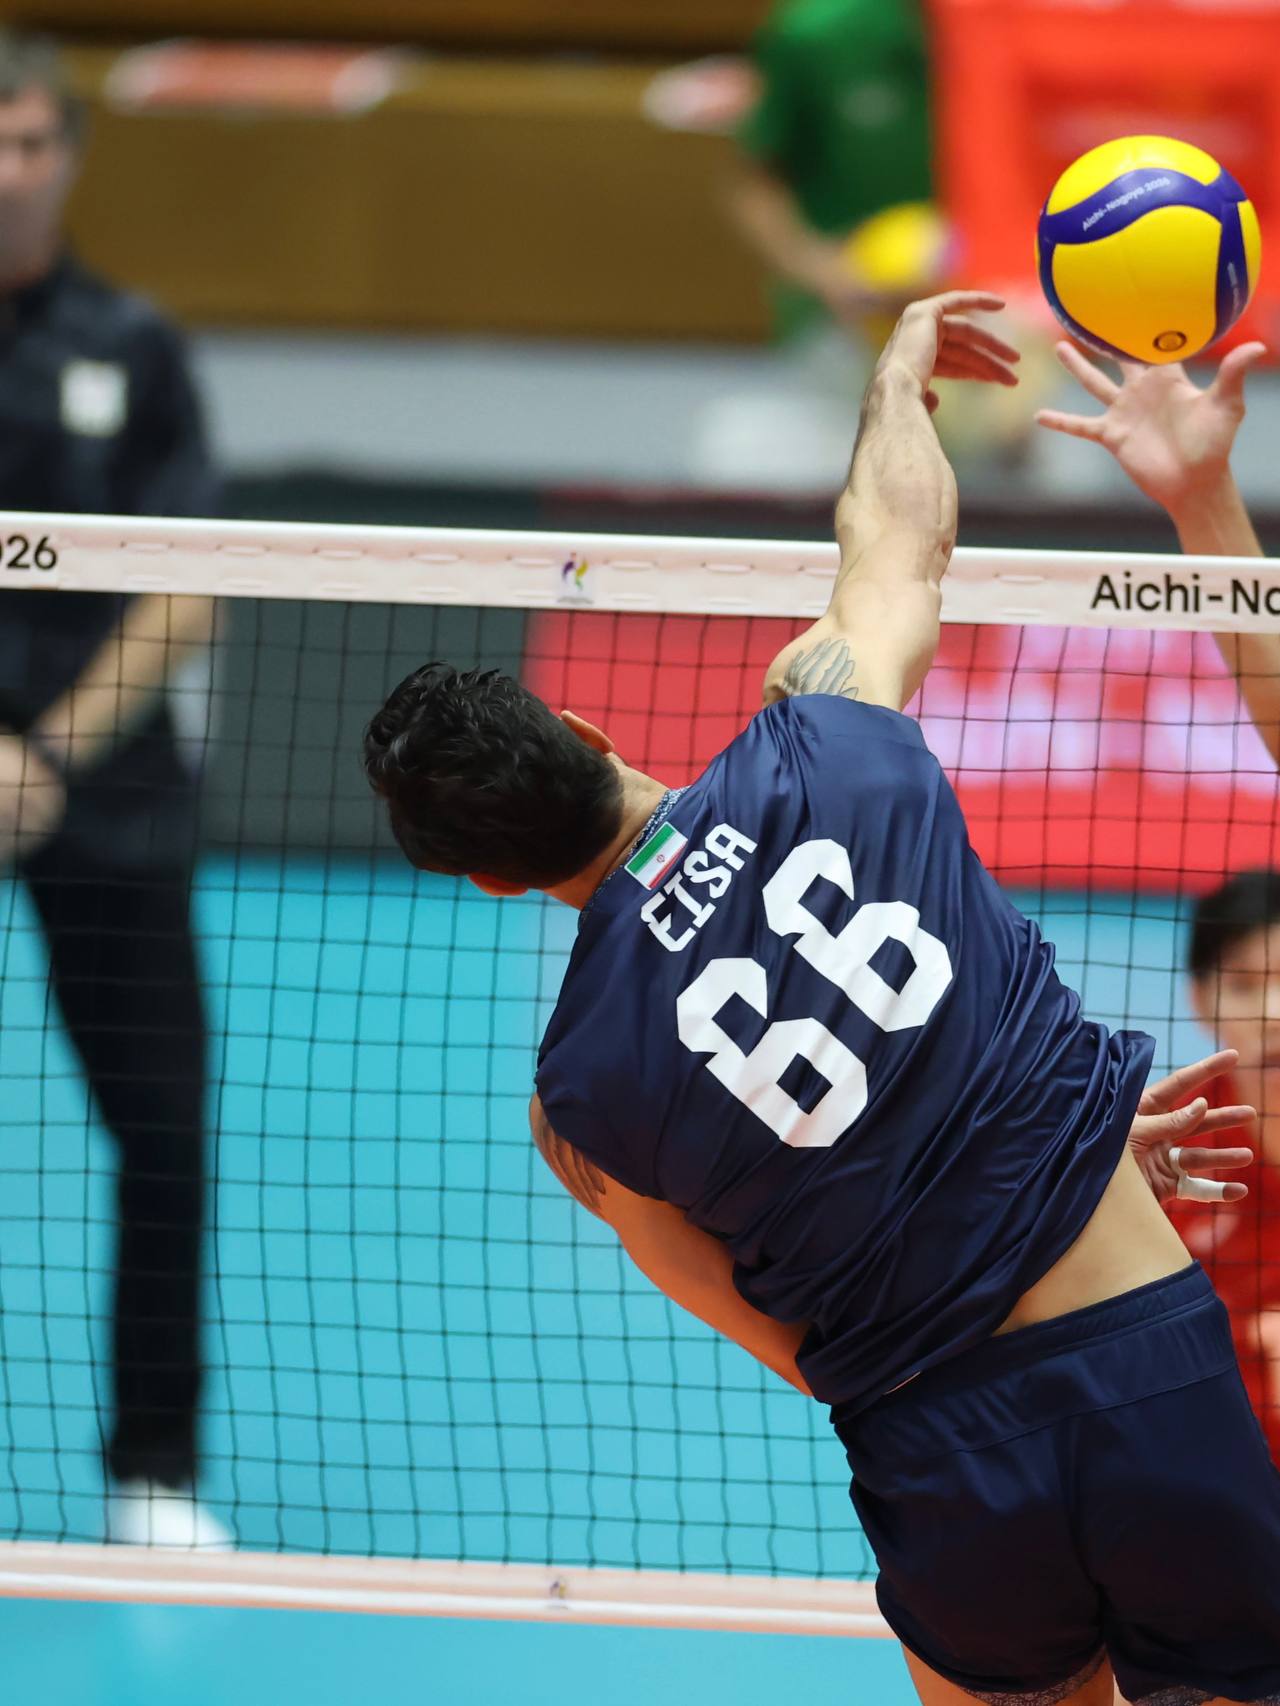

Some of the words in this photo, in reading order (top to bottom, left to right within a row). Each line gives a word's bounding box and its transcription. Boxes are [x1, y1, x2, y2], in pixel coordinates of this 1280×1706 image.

[1082, 186, 1145, 232] Aichi-Nagoya
[1144, 176, 1171, 193] 2026
[0, 534, 57, 571] 26
[640, 822, 758, 952] EISA
[676, 838, 953, 1148] 66
